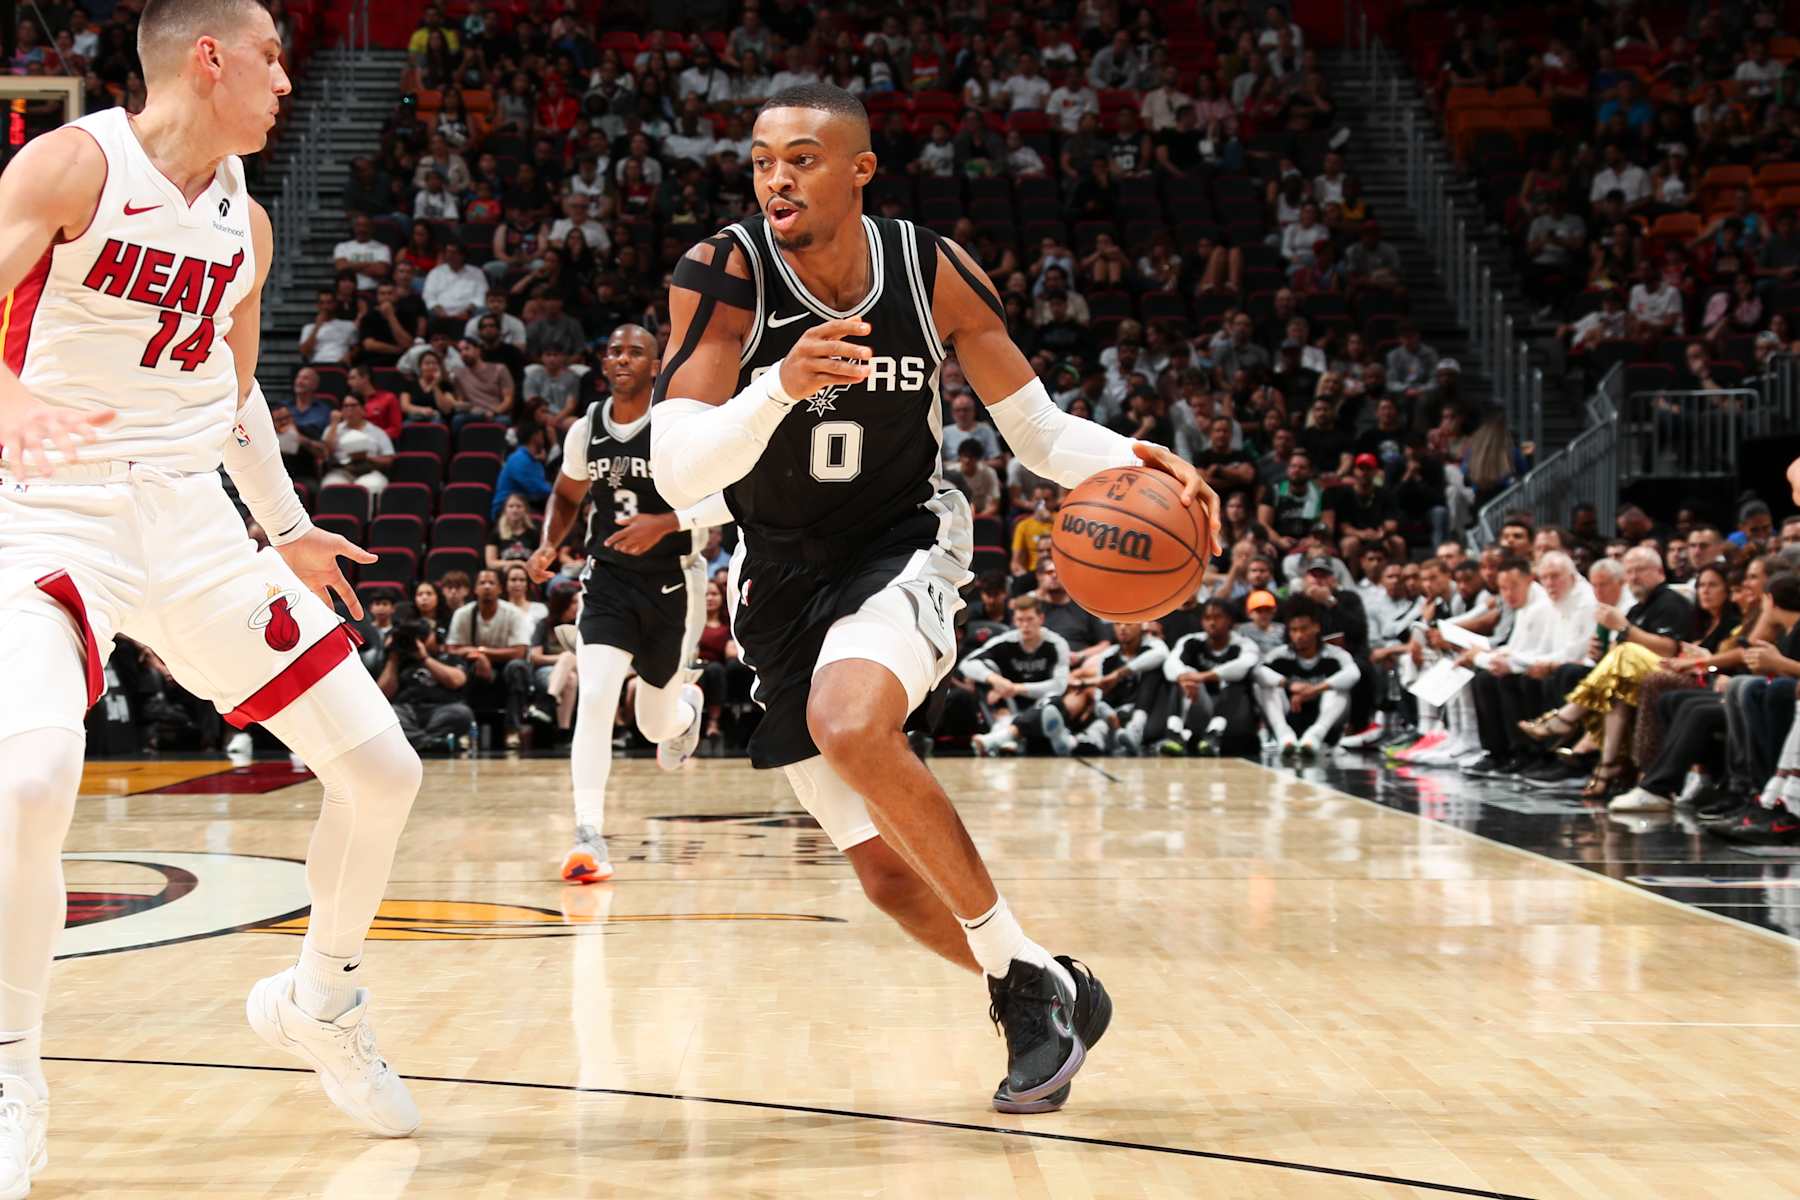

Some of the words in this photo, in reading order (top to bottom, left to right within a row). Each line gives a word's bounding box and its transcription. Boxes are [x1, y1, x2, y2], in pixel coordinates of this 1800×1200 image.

[82, 238, 245, 317] HEAT
[140, 310, 215, 371] 14
[809, 420, 864, 483] 0
[613, 489, 638, 526] 3
[1061, 513, 1153, 562] Wilson
